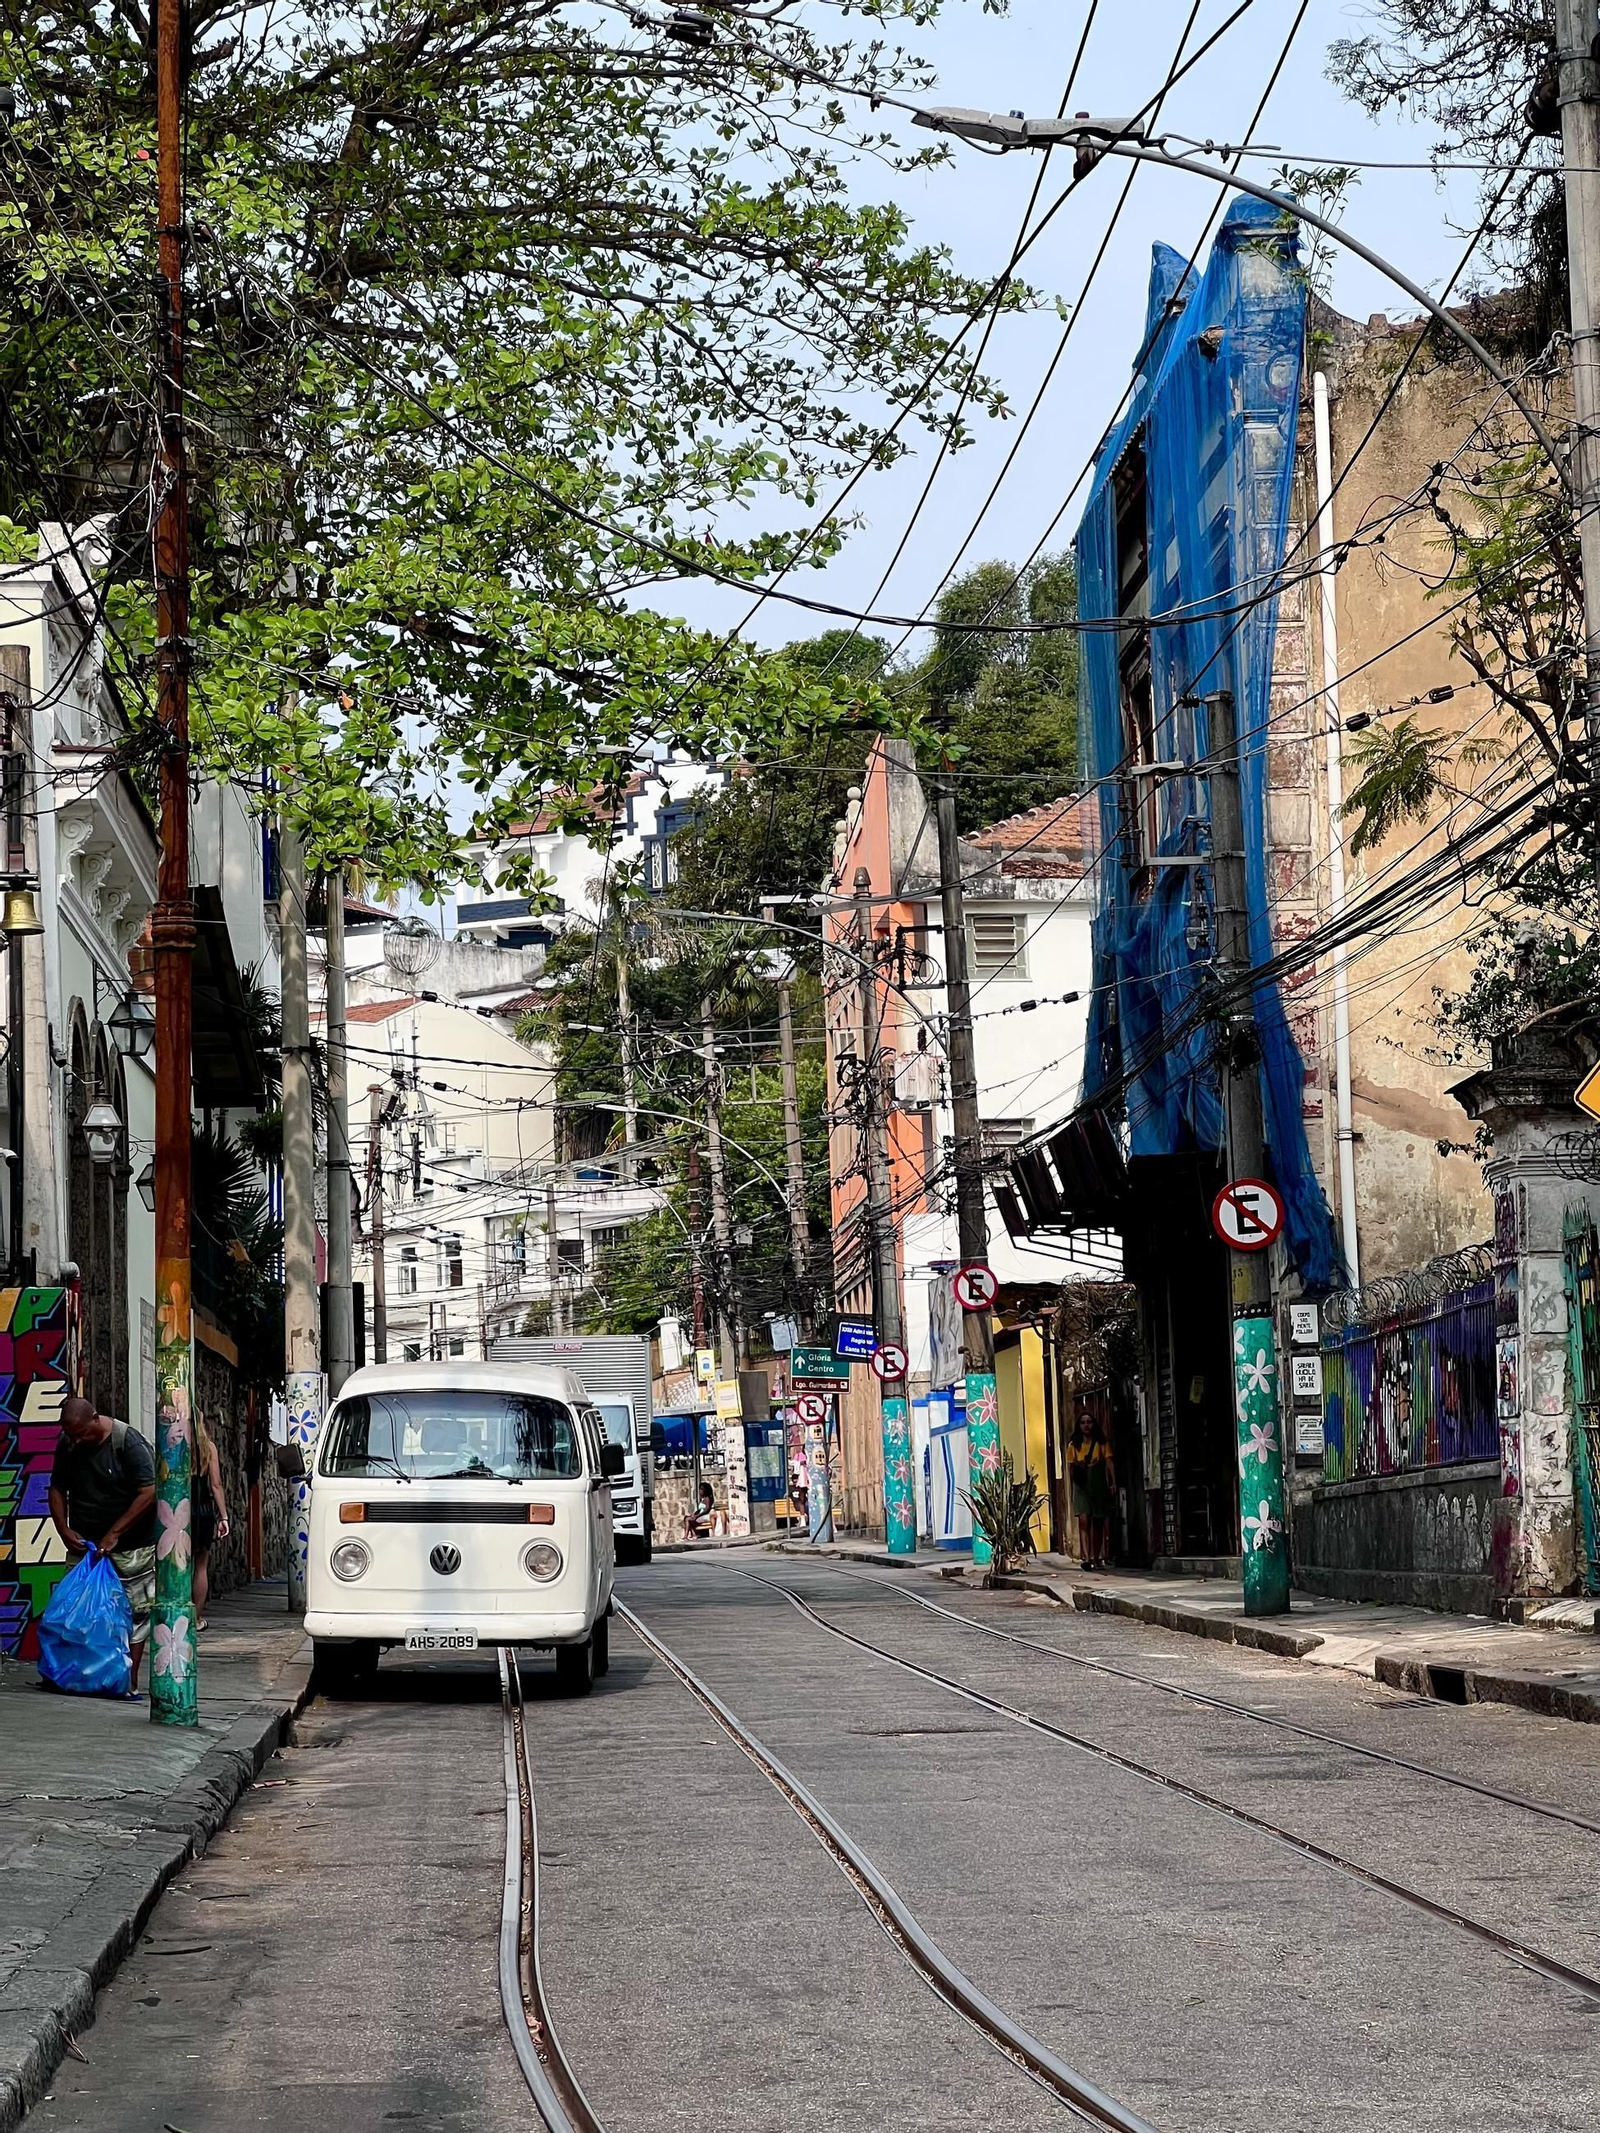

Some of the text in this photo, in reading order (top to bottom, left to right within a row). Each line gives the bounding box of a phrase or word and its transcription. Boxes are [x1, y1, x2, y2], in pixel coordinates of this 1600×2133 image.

[808, 1353, 831, 1361] Glória
[807, 1365, 834, 1373] Centro
[410, 1636, 473, 1648] AHS-2089
